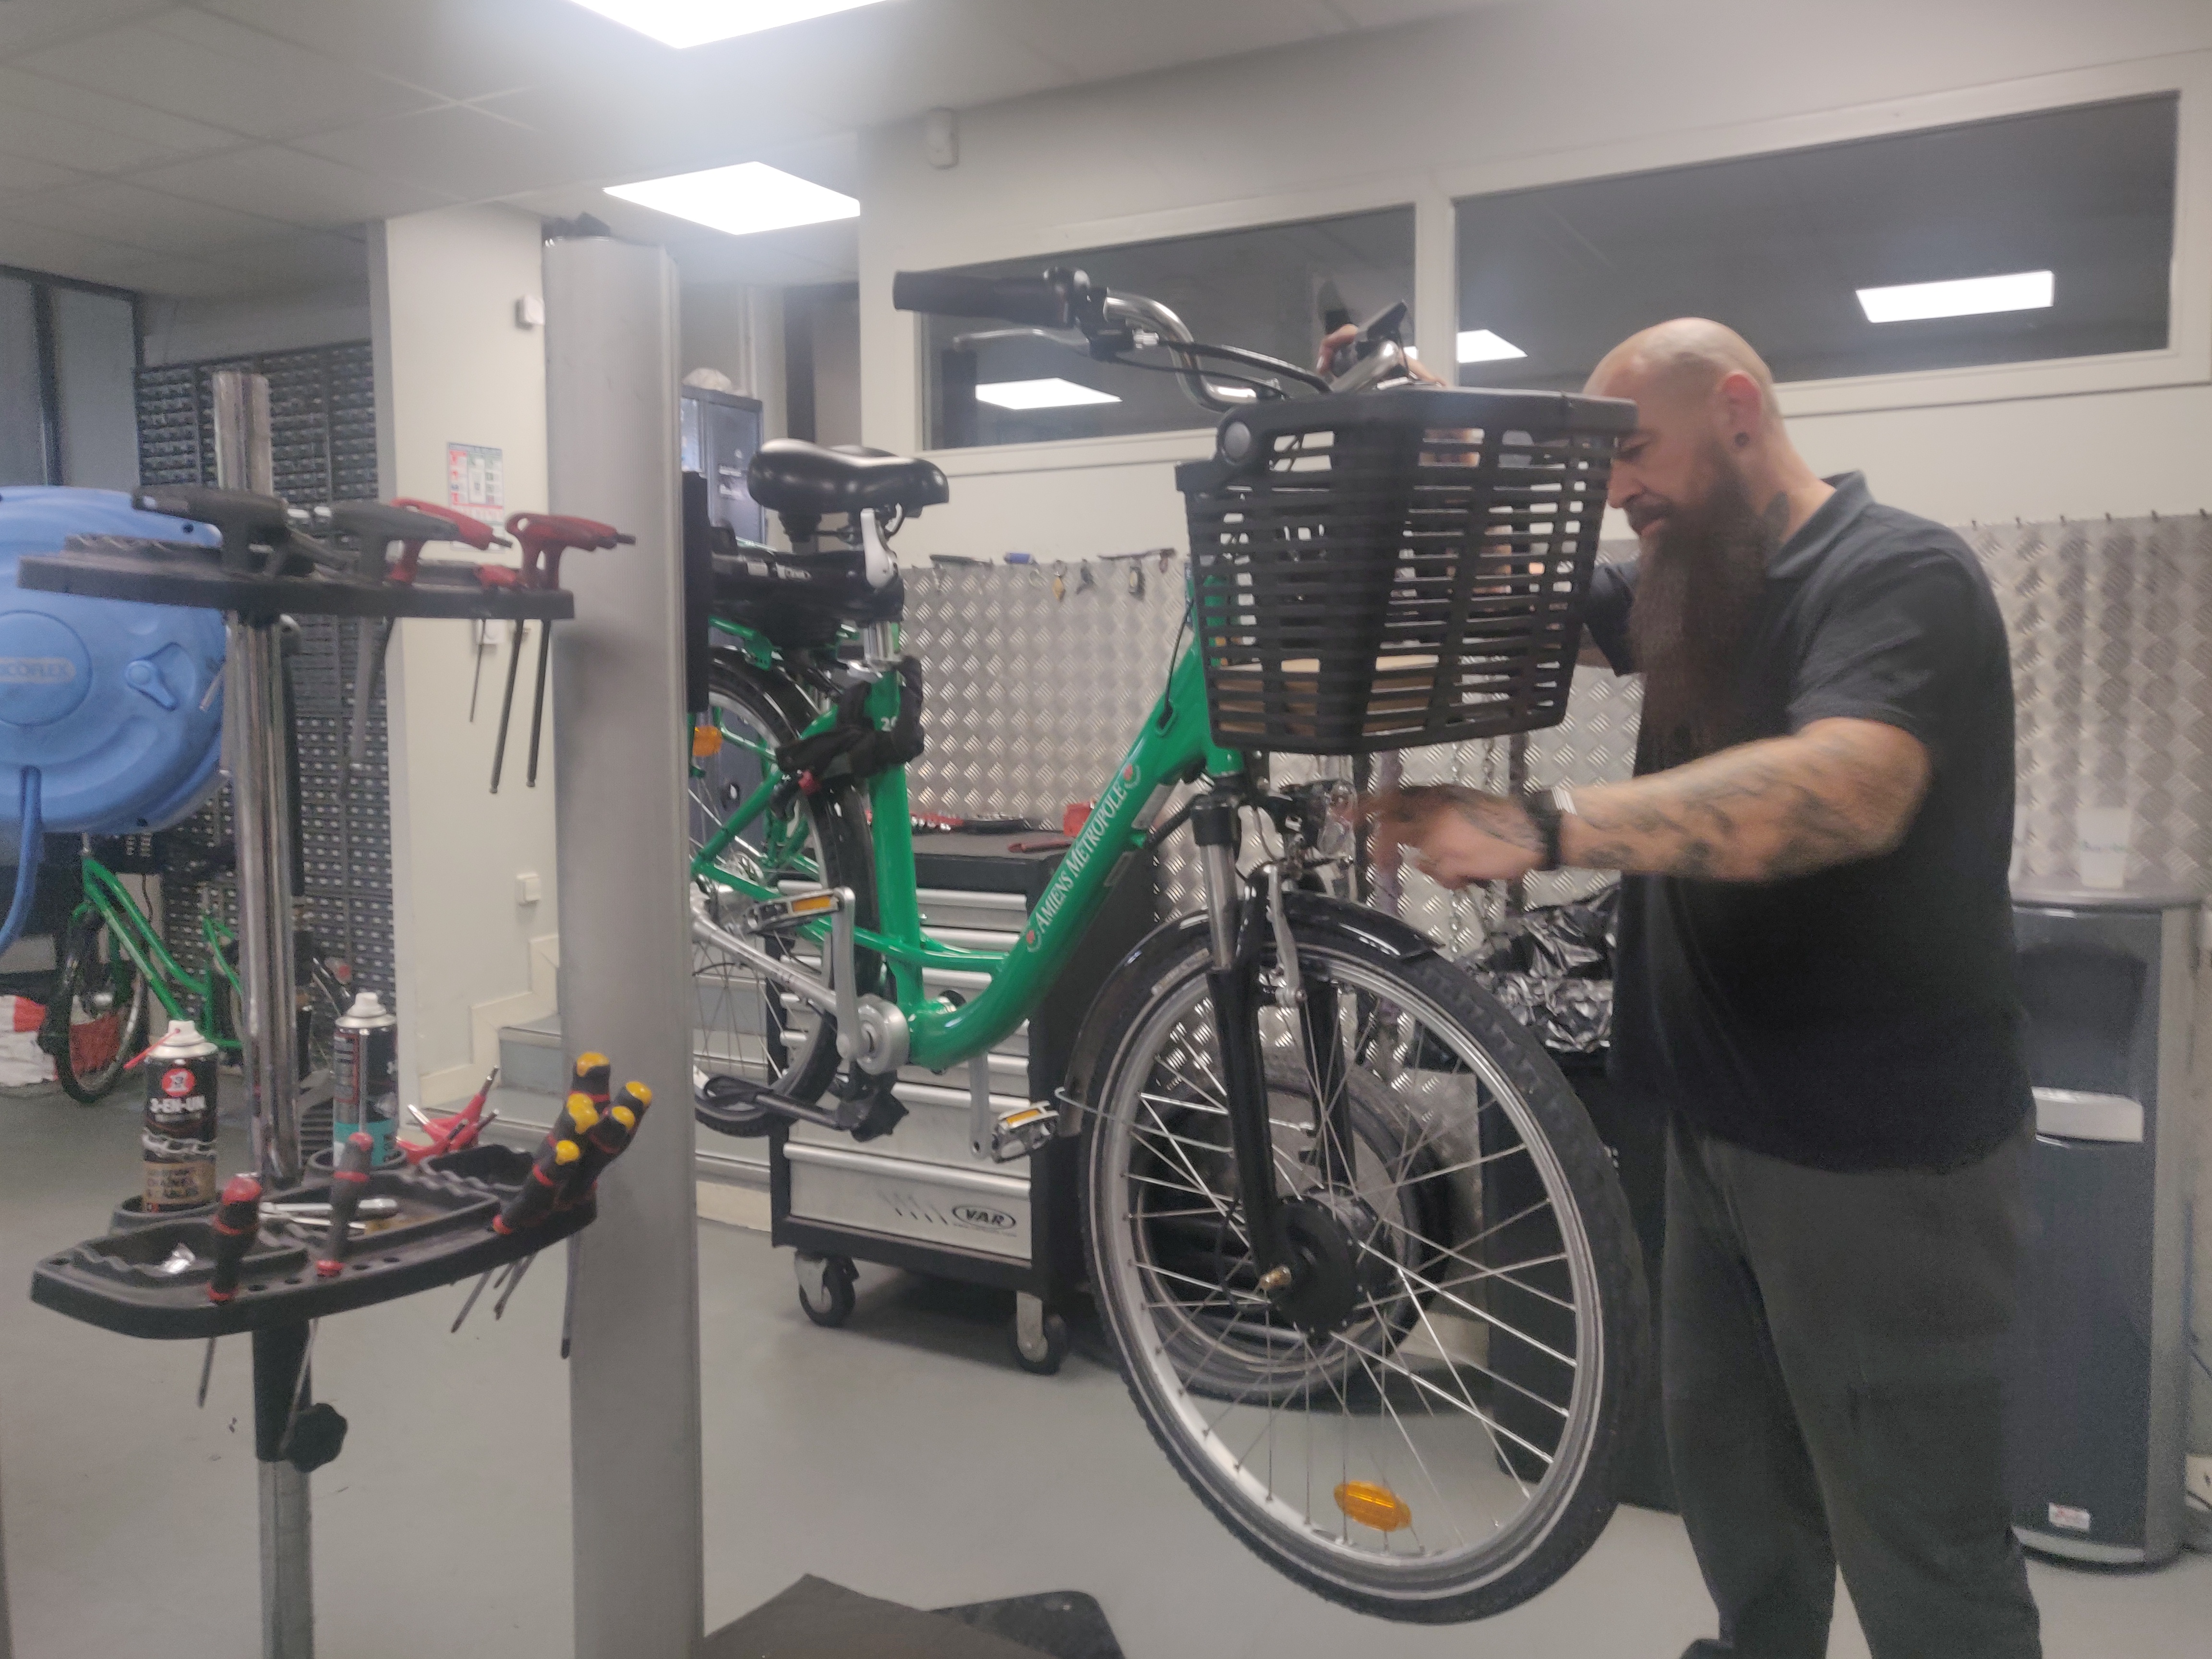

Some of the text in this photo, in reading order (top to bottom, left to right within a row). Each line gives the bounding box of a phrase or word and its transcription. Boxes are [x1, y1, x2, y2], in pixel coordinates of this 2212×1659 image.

[1035, 870, 1074, 933] AMIENS
[149, 1095, 206, 1114] 3-EN-UN
[966, 1209, 1006, 1226] VAR
